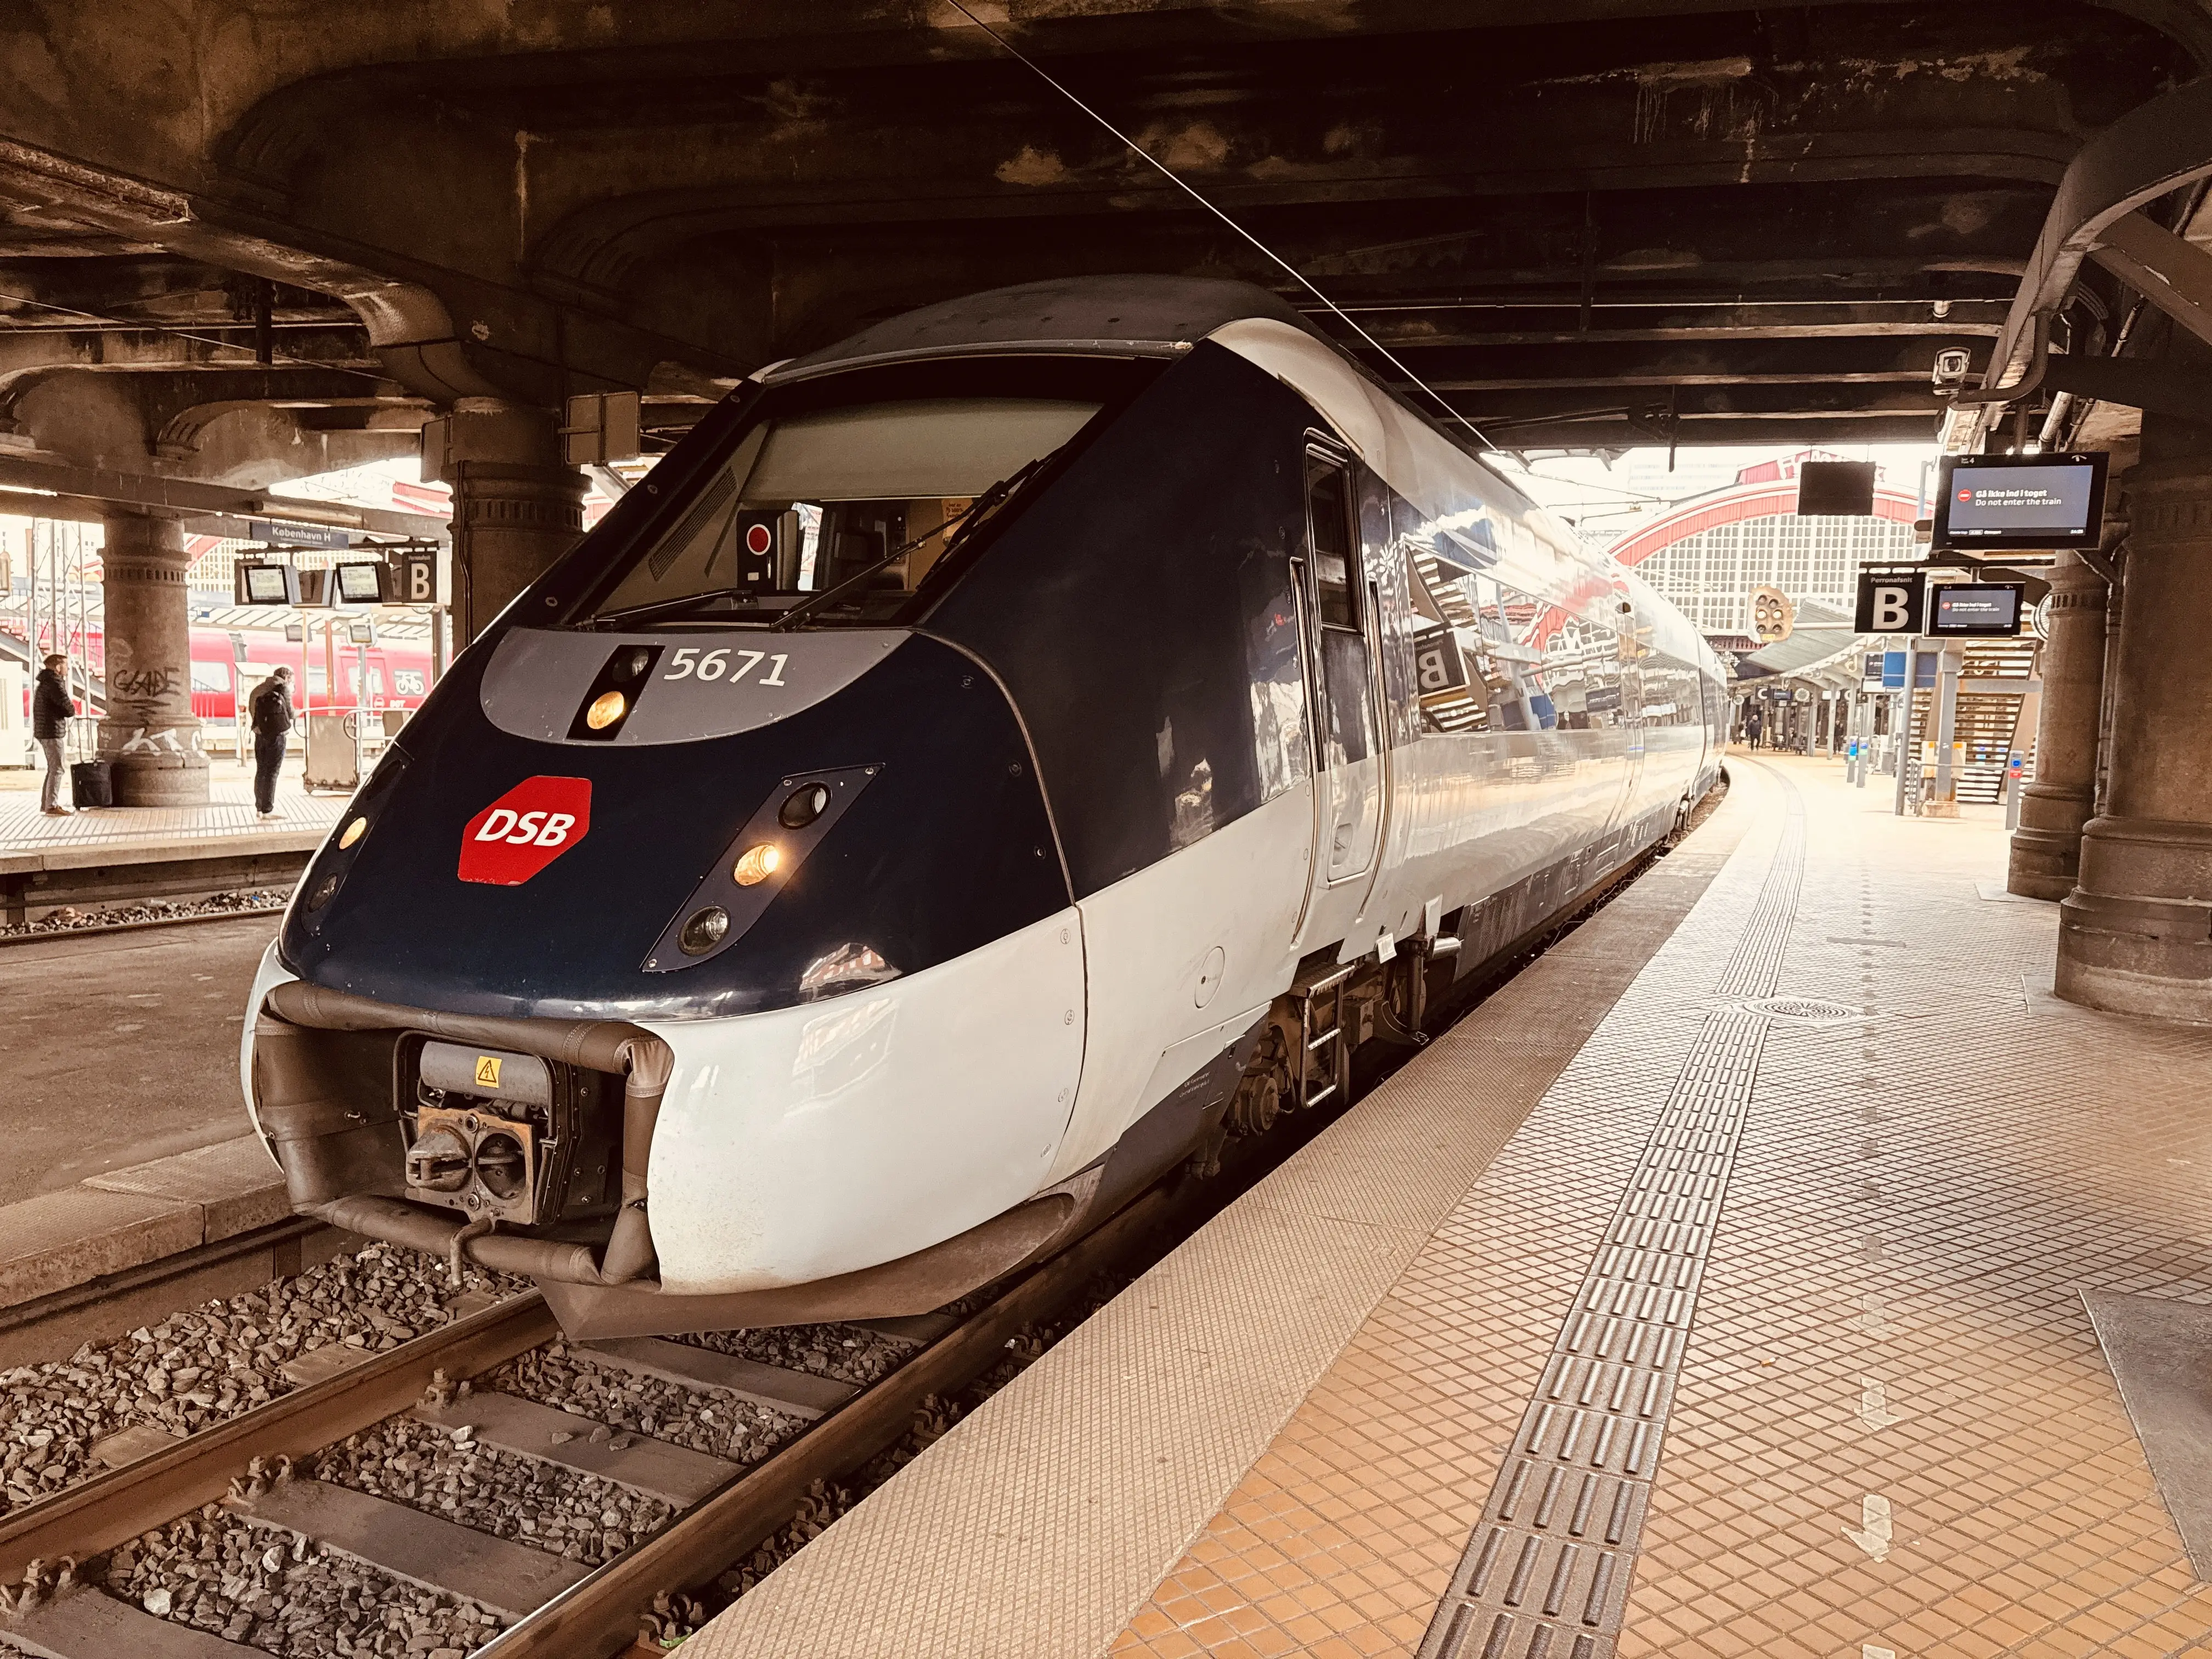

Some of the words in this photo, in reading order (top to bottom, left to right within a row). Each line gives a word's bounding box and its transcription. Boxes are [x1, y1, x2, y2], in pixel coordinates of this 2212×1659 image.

[2024, 489, 2047, 498] toget
[272, 526, 322, 541] København
[324, 532, 331, 542] H
[411, 562, 430, 600] B
[1872, 586, 1909, 630] B
[663, 648, 788, 686] 5671
[1757, 688, 1768, 700] C
[474, 809, 575, 847] DSB
